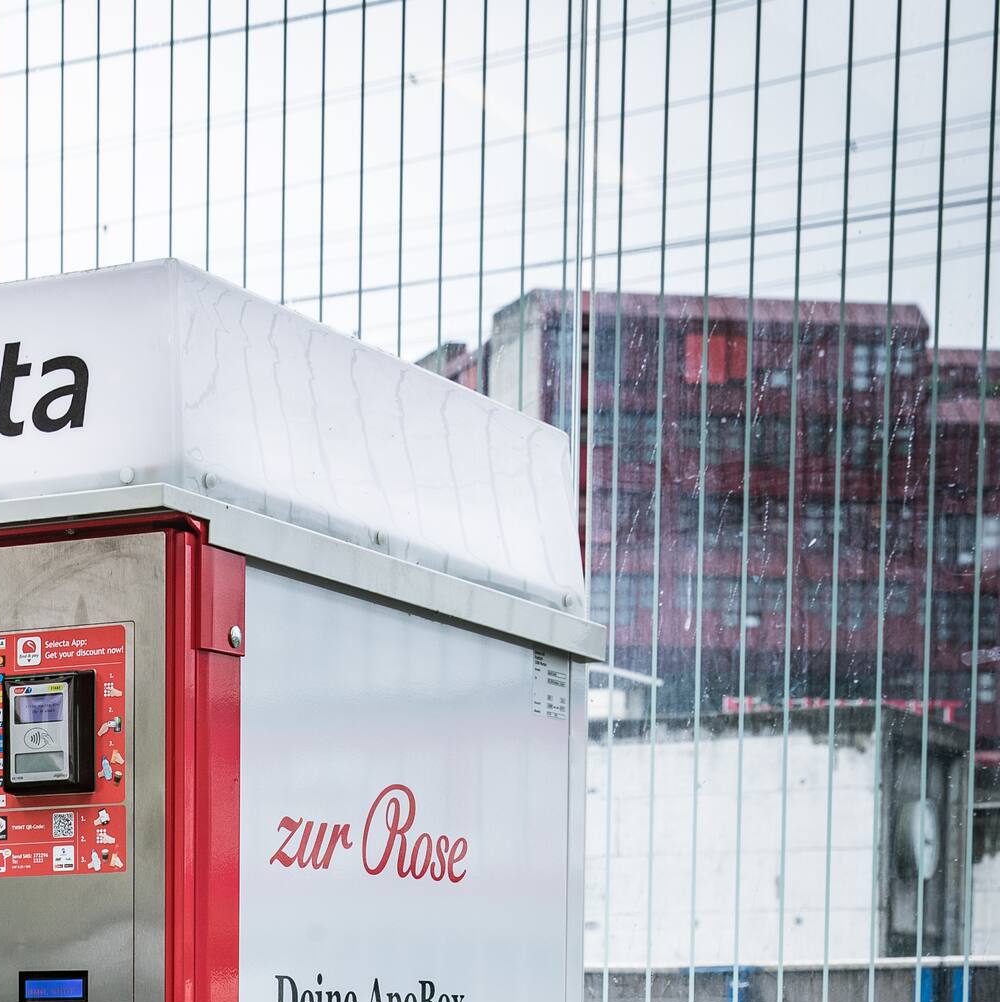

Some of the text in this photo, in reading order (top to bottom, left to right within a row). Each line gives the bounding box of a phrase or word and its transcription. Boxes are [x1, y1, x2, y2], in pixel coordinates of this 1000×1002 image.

[45, 638, 87, 648] Selecta App:
[44, 645, 124, 660] Get your discount now!
[269, 783, 469, 883] zur Rose
